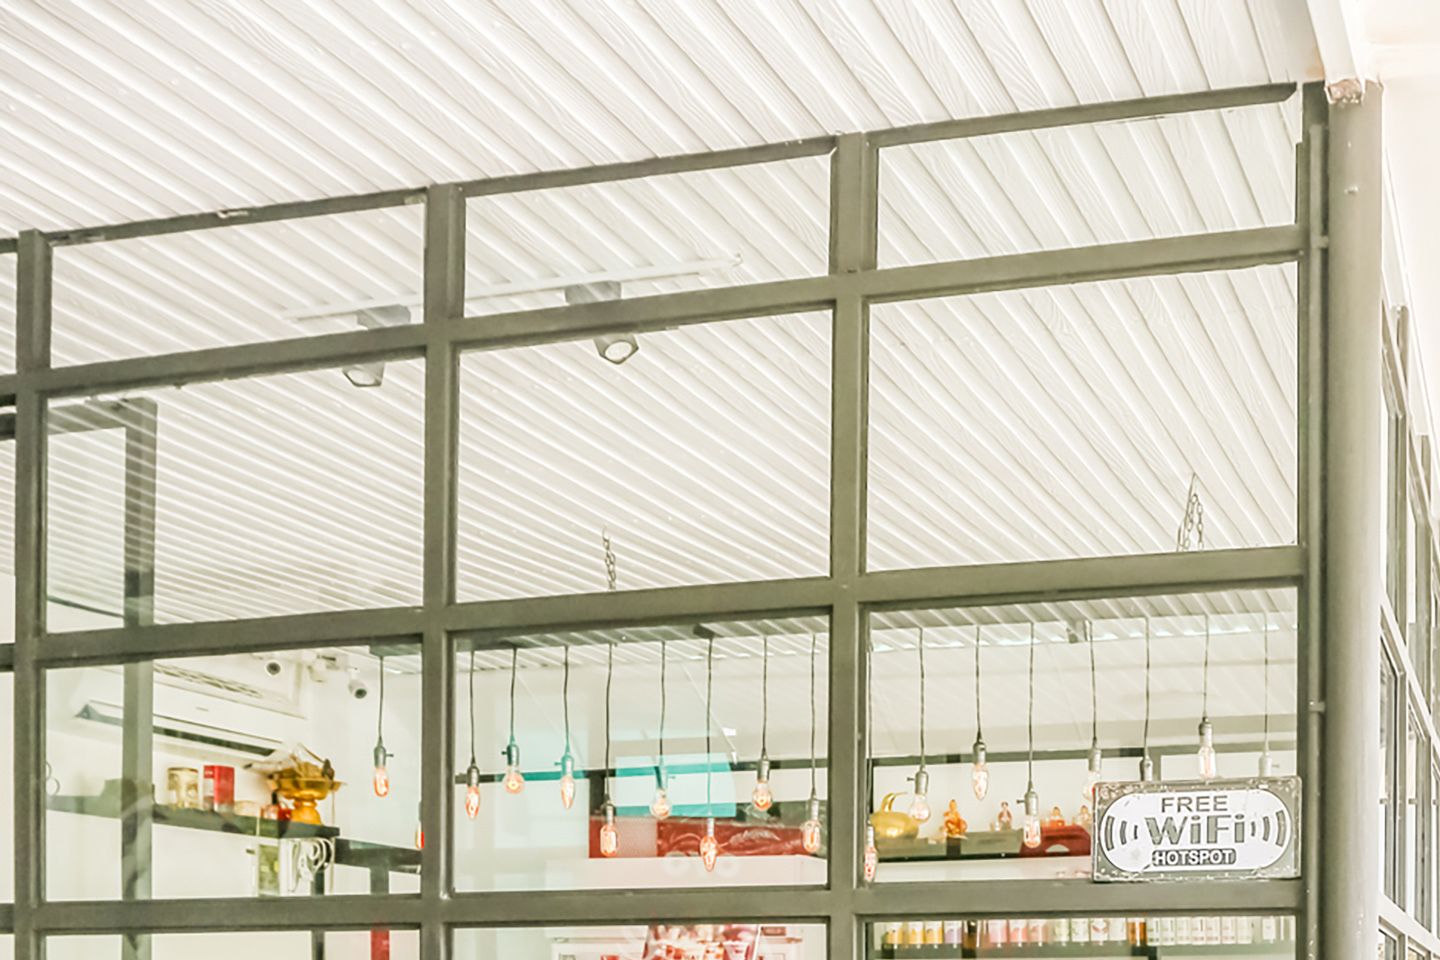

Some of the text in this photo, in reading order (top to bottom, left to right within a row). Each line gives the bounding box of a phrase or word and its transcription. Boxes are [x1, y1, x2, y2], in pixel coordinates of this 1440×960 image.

[1161, 795, 1228, 812] FREE
[1144, 814, 1246, 845] WiFi
[1154, 850, 1233, 865] HOTSPOT
